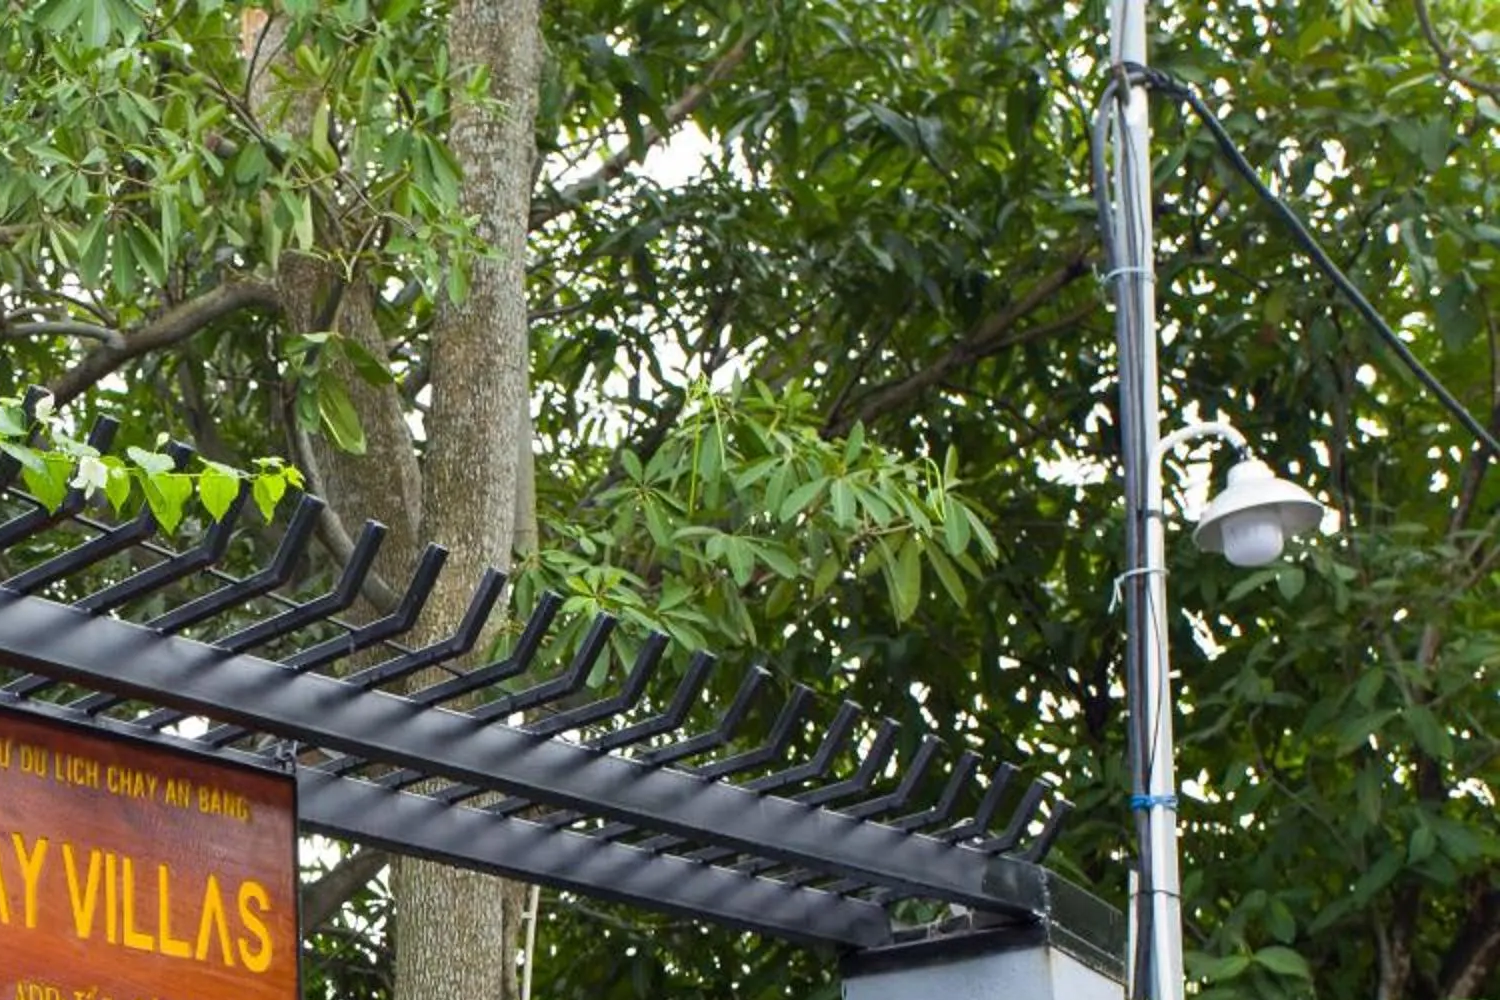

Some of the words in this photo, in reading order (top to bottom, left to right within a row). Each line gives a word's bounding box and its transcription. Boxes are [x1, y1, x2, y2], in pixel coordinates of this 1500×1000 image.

[107, 765, 157, 800] CHAY
[165, 777, 191, 809] AN
[62, 840, 273, 974] VILLAS
